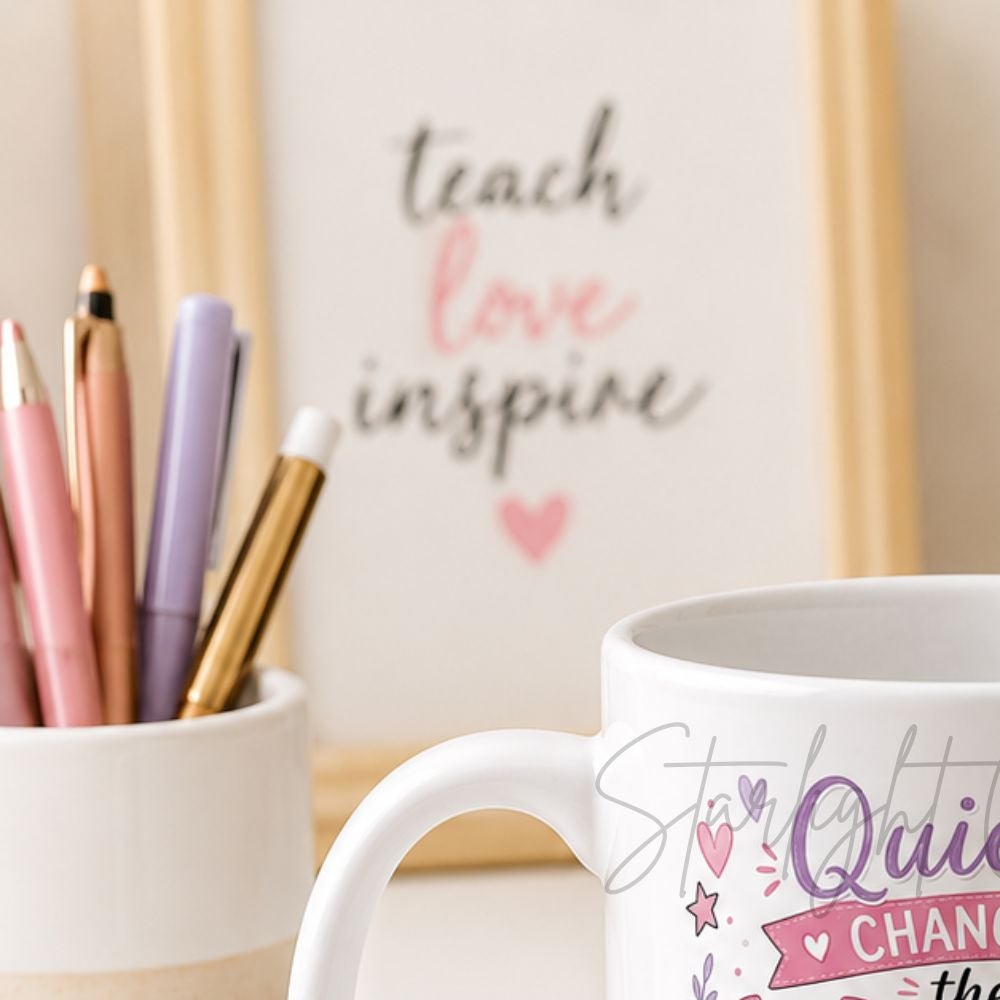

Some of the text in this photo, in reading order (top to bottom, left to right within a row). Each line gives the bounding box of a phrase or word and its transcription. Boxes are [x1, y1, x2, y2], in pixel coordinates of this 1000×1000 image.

[394, 98, 650, 226] teach
[427, 216, 640, 356] love
[352, 352, 709, 482] inspire
